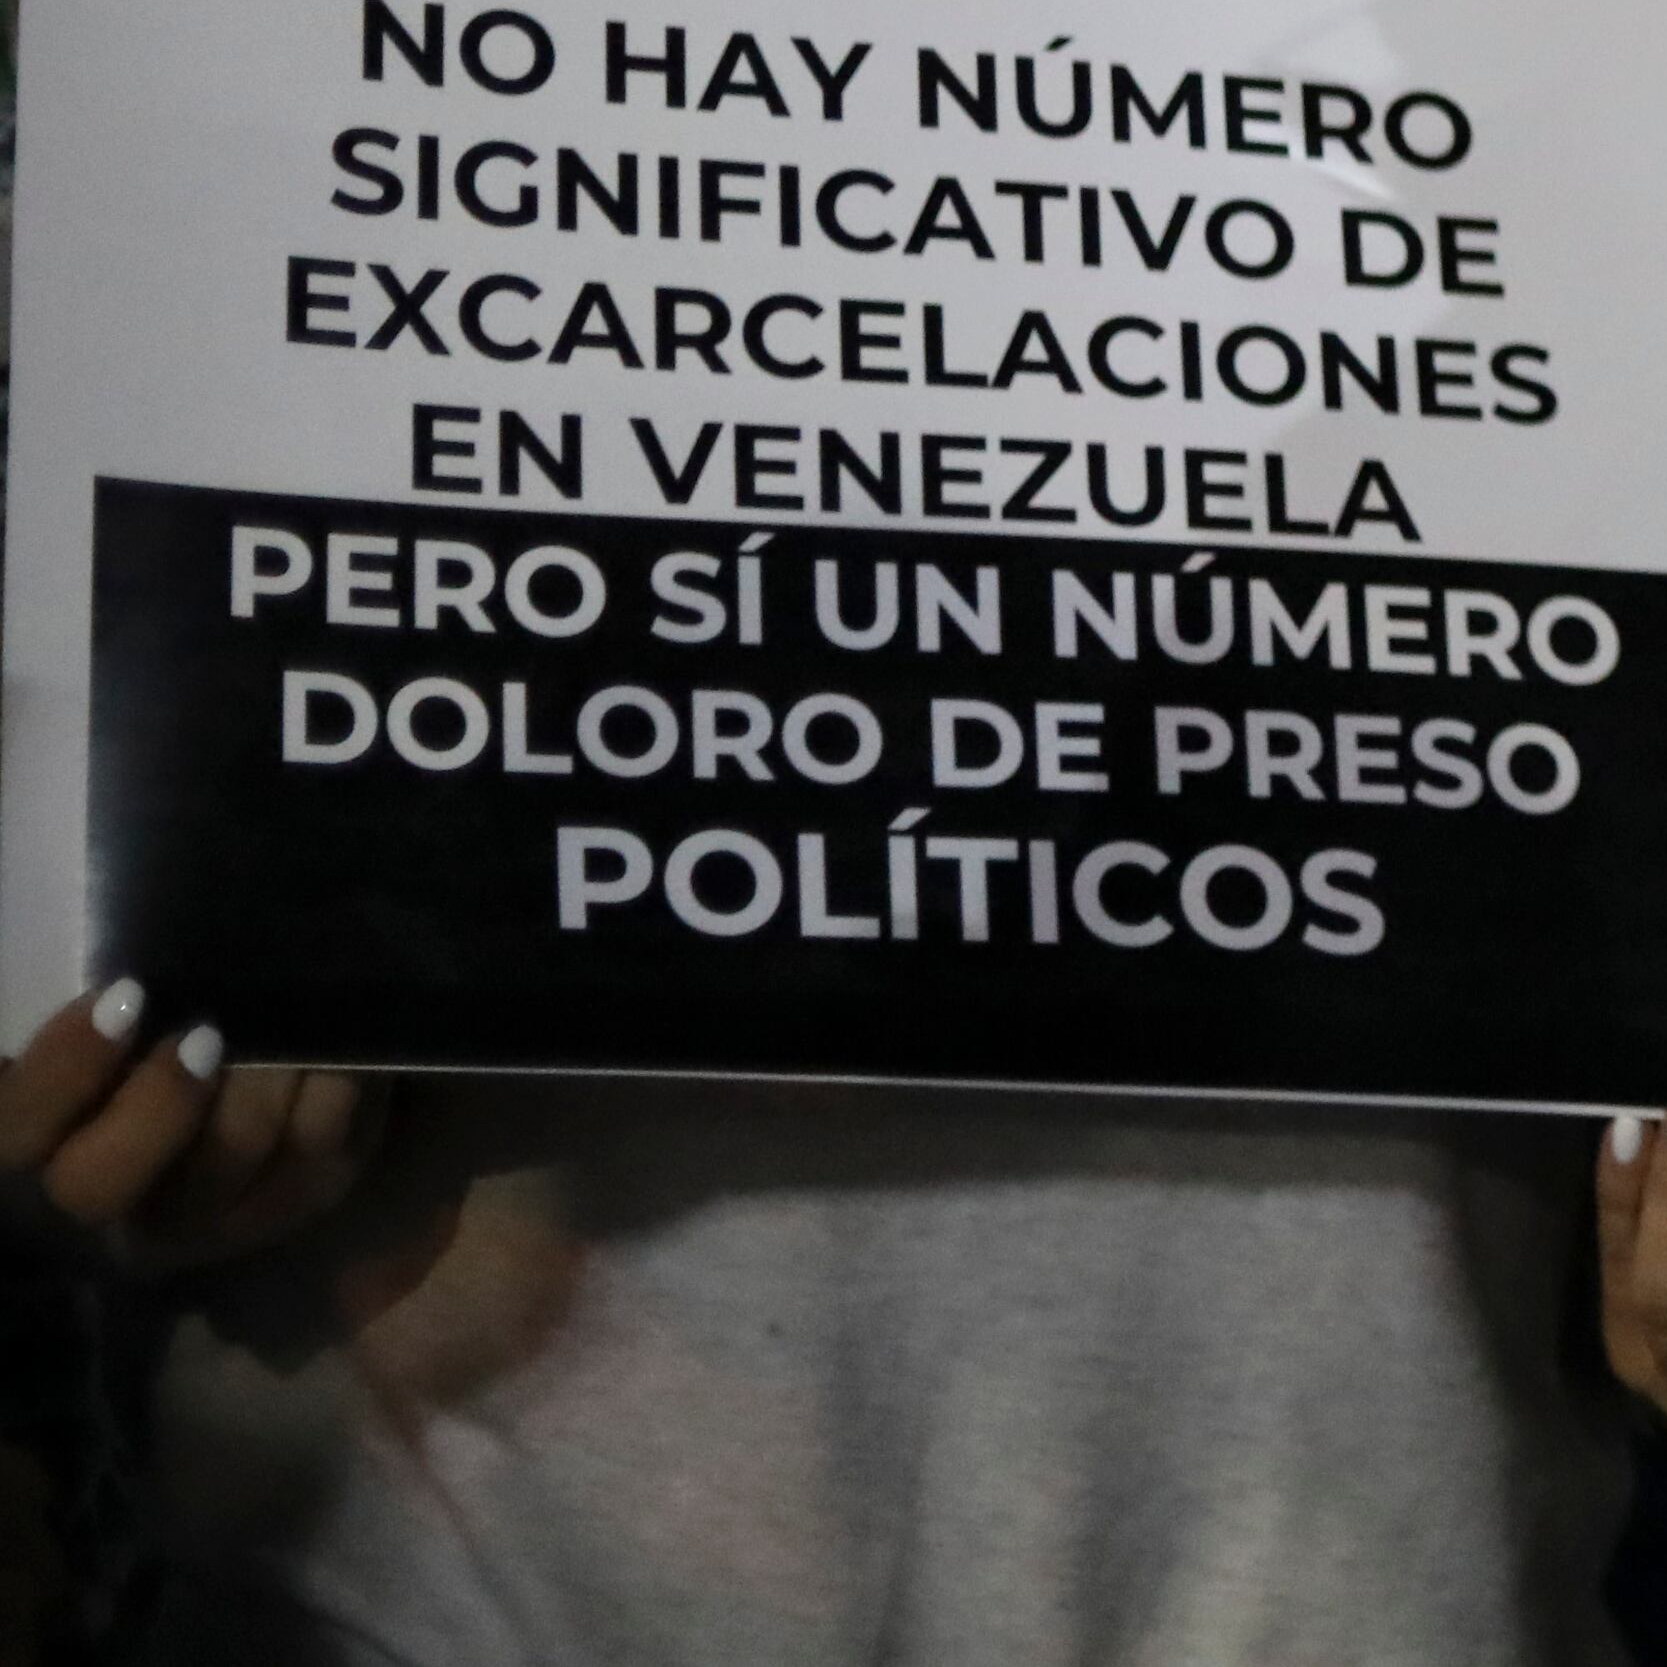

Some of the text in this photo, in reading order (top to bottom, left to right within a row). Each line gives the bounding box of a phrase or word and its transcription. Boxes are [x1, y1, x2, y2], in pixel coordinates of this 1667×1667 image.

[605, 19, 873, 122] HAY
[917, 36, 1474, 171] NÚMERO
[330, 128, 1505, 298] SIGNIFICATIVO DE
[285, 255, 1559, 427] EXCARCELACIONES
[411, 402, 1423, 543] EN VENEZUELA
[230, 525, 1621, 687] PERO SÍ UN NÚMERO
[282, 670, 1581, 816] DOLORO DE PRESO
[556, 807, 1387, 957] POLÍTICOS
